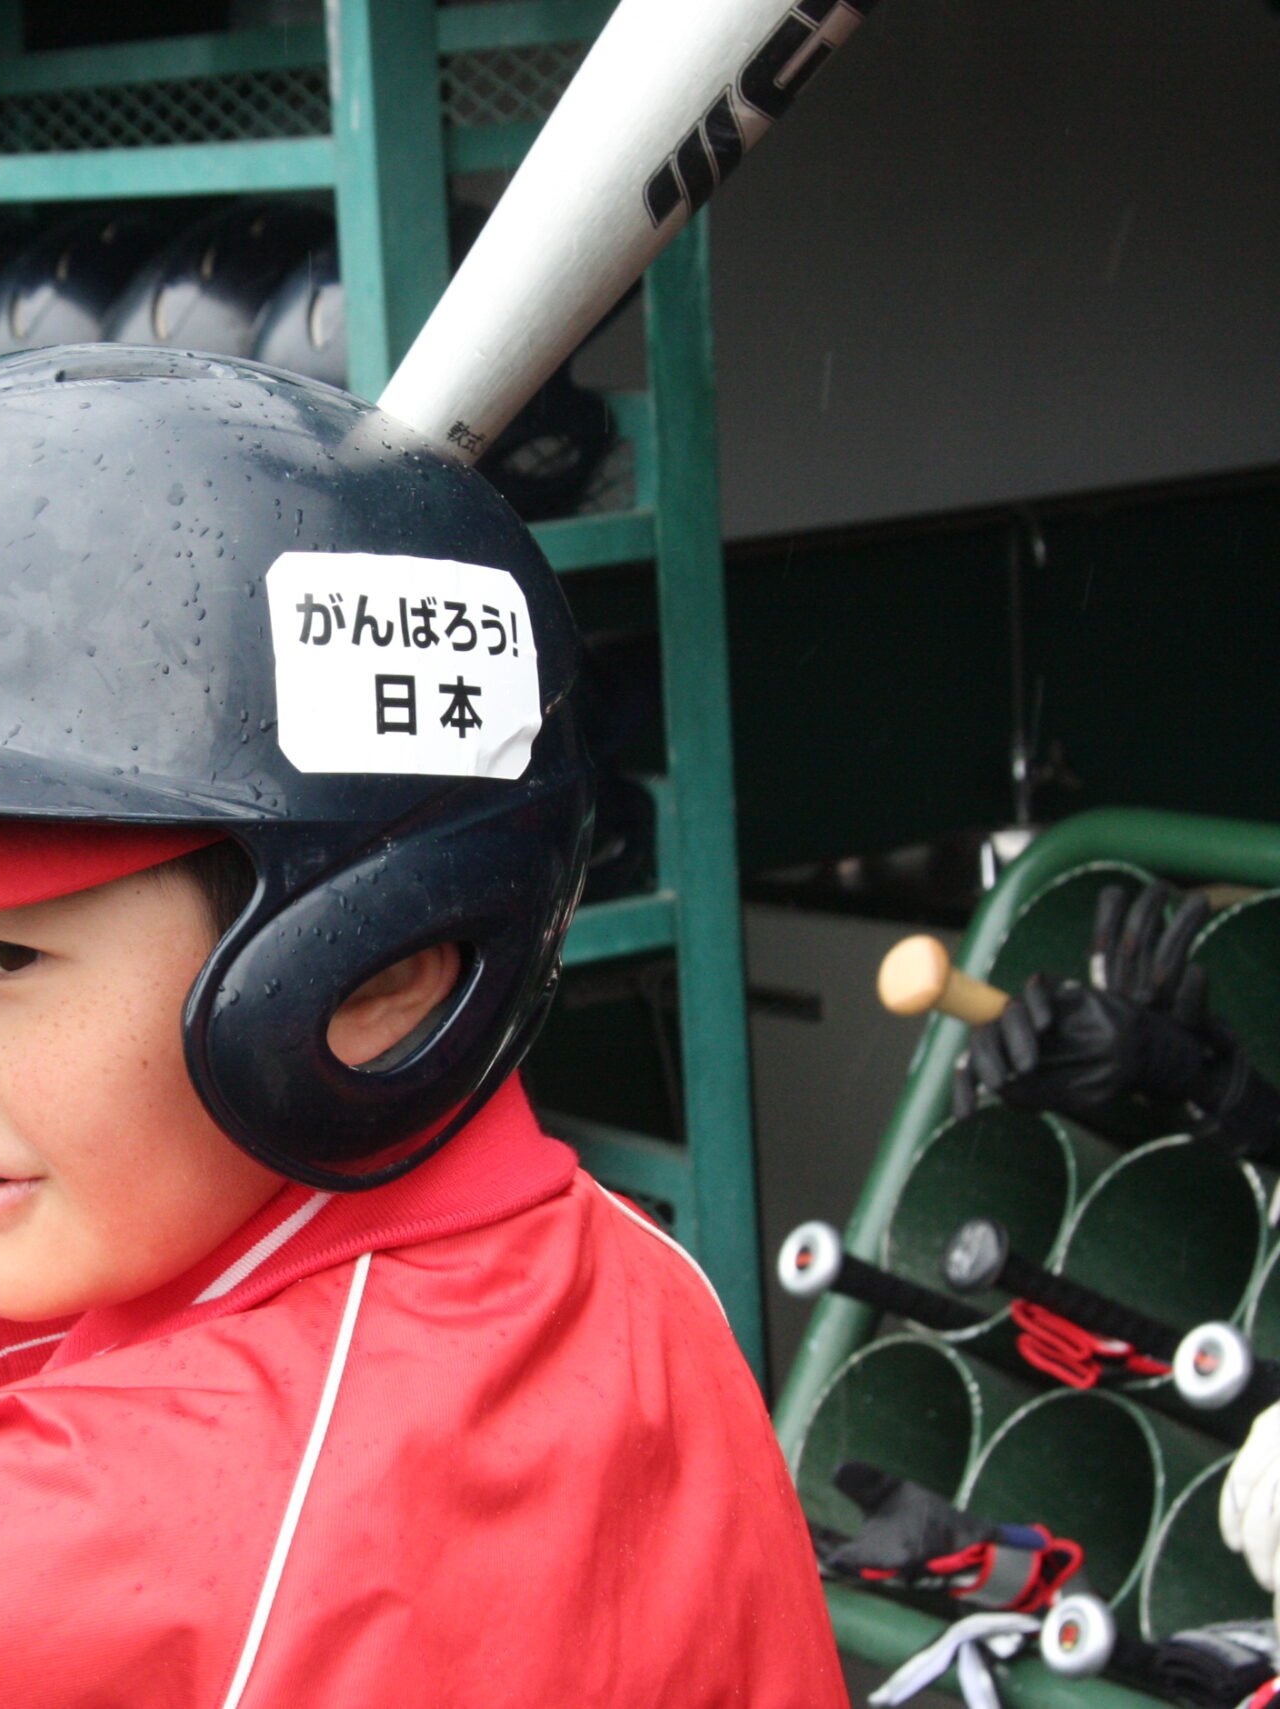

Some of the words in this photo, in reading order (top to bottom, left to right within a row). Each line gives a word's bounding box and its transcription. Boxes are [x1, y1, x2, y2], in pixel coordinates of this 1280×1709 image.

[296, 592, 519, 658] がんばろう!
[375, 673, 484, 739] 日本
